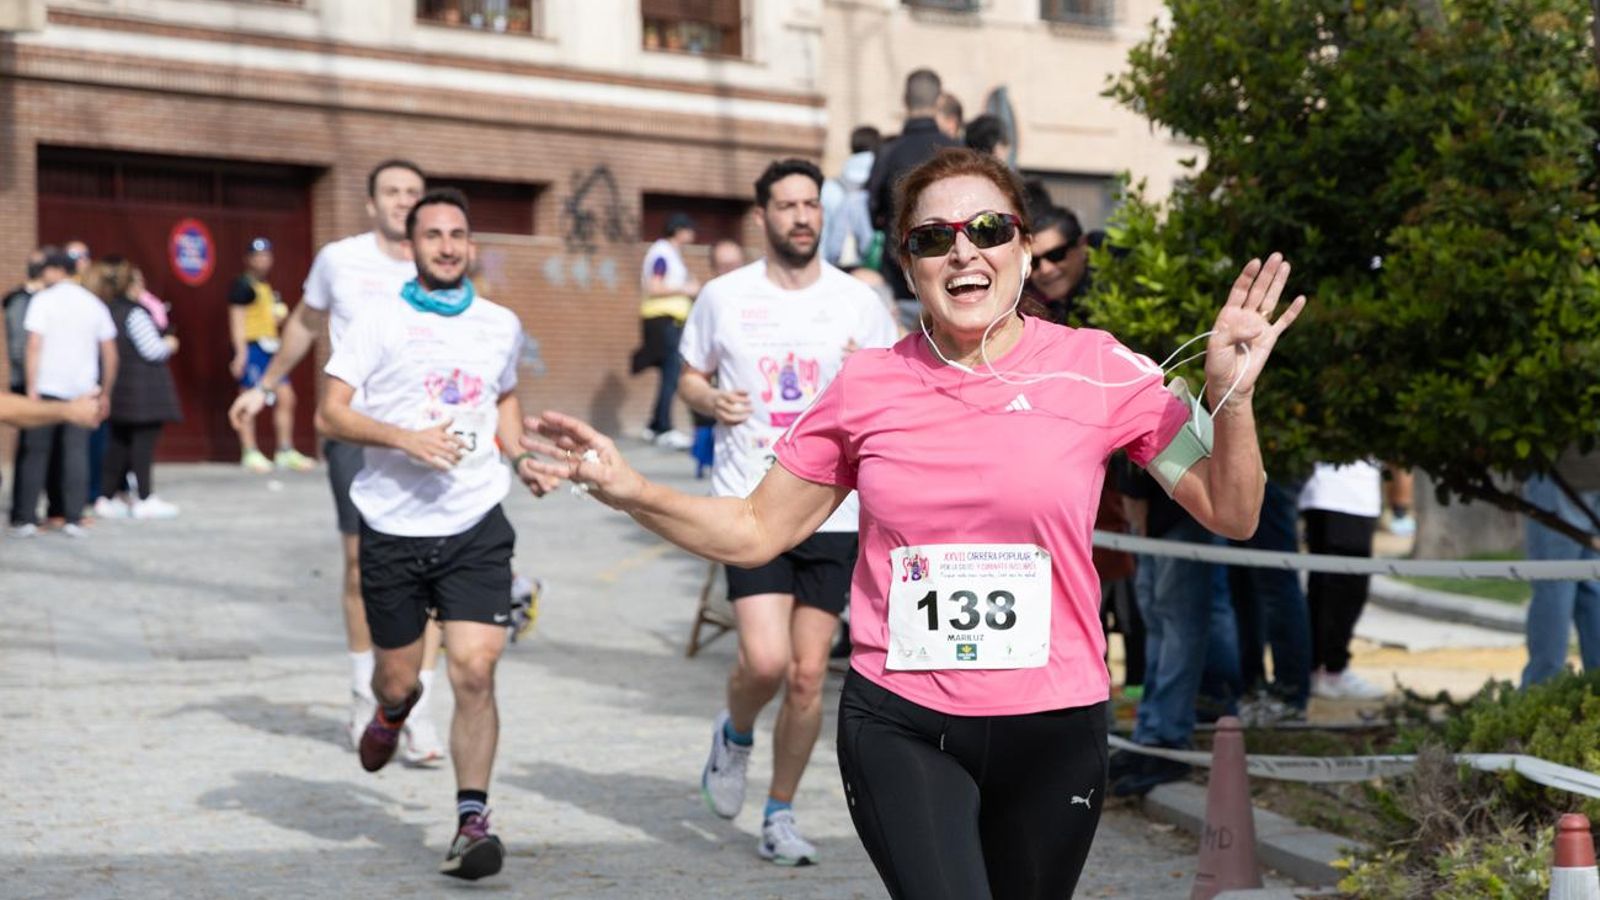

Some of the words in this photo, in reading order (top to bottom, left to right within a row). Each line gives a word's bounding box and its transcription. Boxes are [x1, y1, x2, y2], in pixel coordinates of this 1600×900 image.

[967, 551, 998, 561] CARRERA
[999, 551, 1032, 561] POPULAR
[917, 590, 1017, 631] 138
[947, 634, 985, 642] MARILUZ
